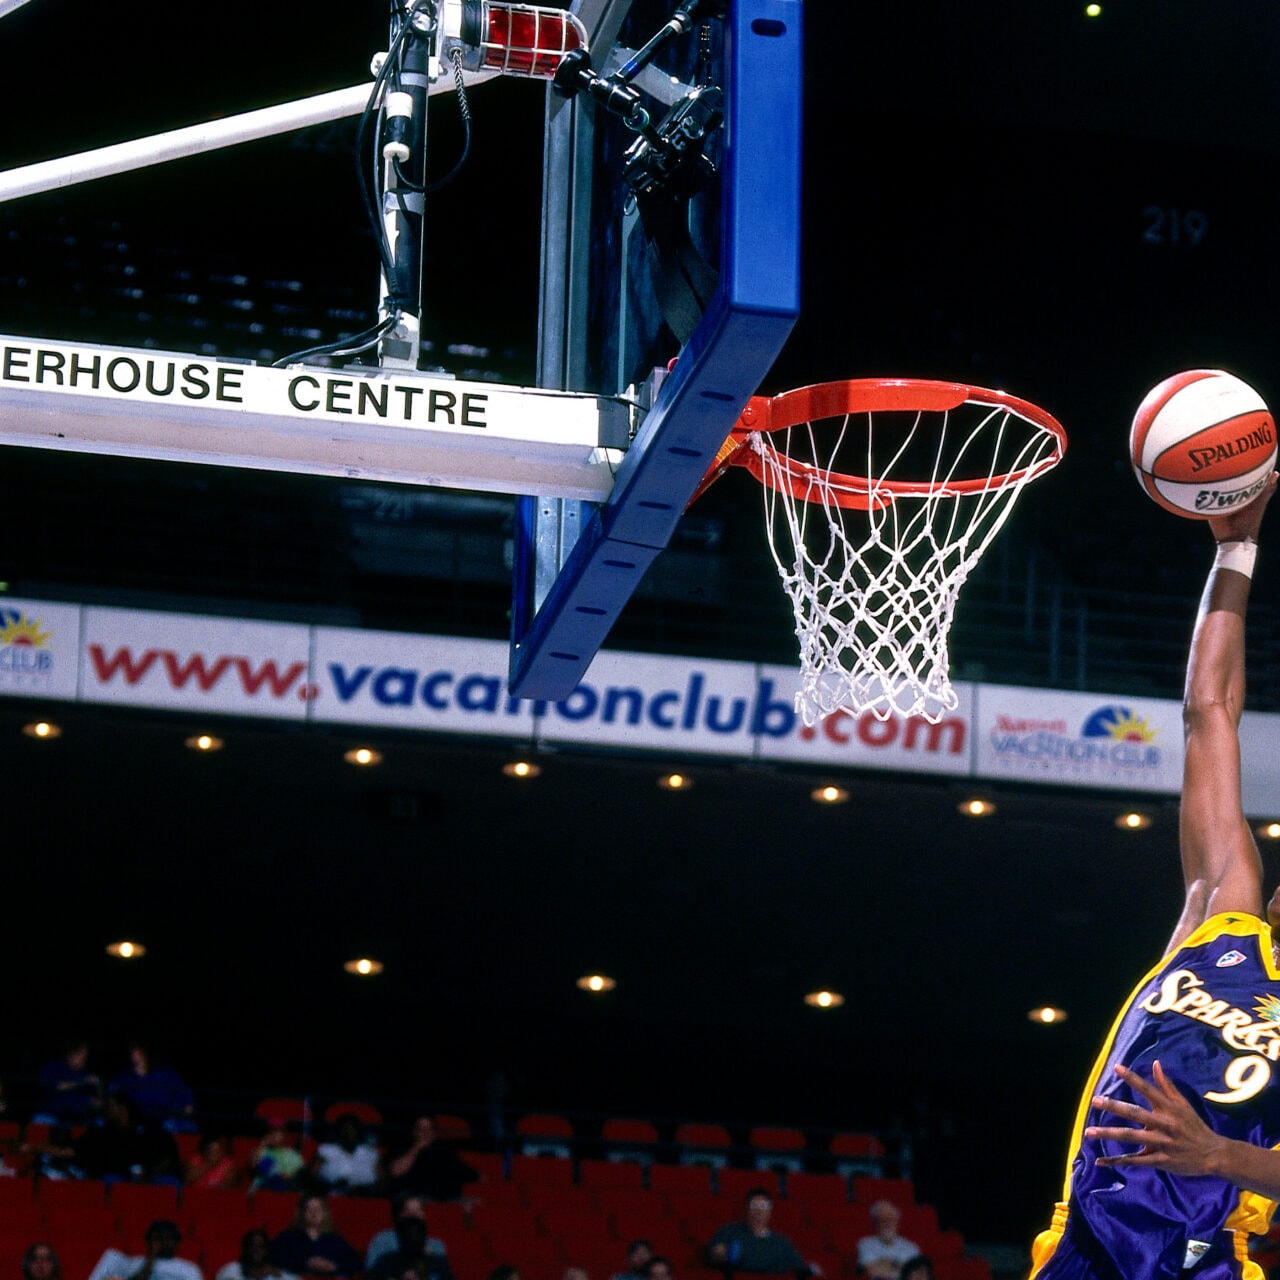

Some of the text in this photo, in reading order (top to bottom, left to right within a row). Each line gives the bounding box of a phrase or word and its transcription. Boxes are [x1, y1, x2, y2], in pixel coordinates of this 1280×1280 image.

[2, 346, 489, 428] ERHOUSE CENTRE
[1188, 421, 1273, 473] SPALDING
[1203, 1054, 1271, 1104] 9
